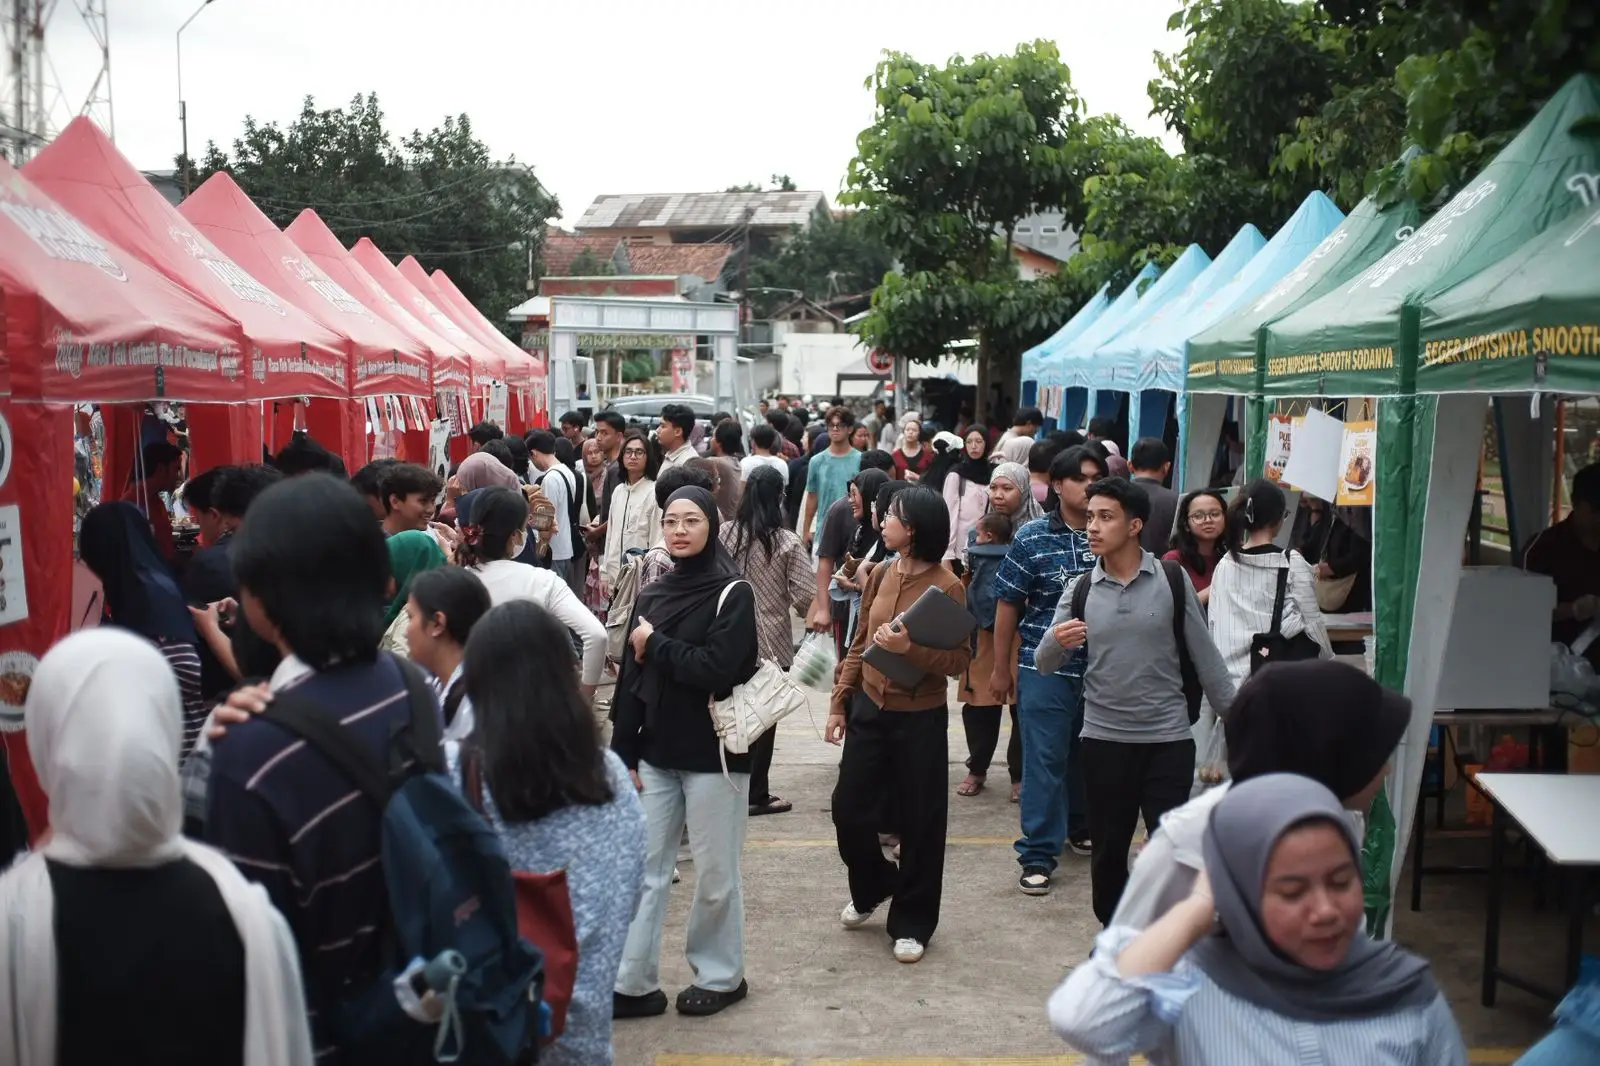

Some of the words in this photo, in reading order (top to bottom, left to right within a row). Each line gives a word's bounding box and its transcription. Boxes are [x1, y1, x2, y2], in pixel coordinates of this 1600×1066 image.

[1267, 356, 1287, 376] SEGER
[1287, 353, 1318, 375] NIPISNYA
[1318, 350, 1351, 372] SMOOTH
[1352, 347, 1394, 371] SODANYA
[1425, 339, 1462, 365] SEGER
[1463, 330, 1529, 361] NIPISNYA
[1533, 325, 1600, 356] SMOOTH
